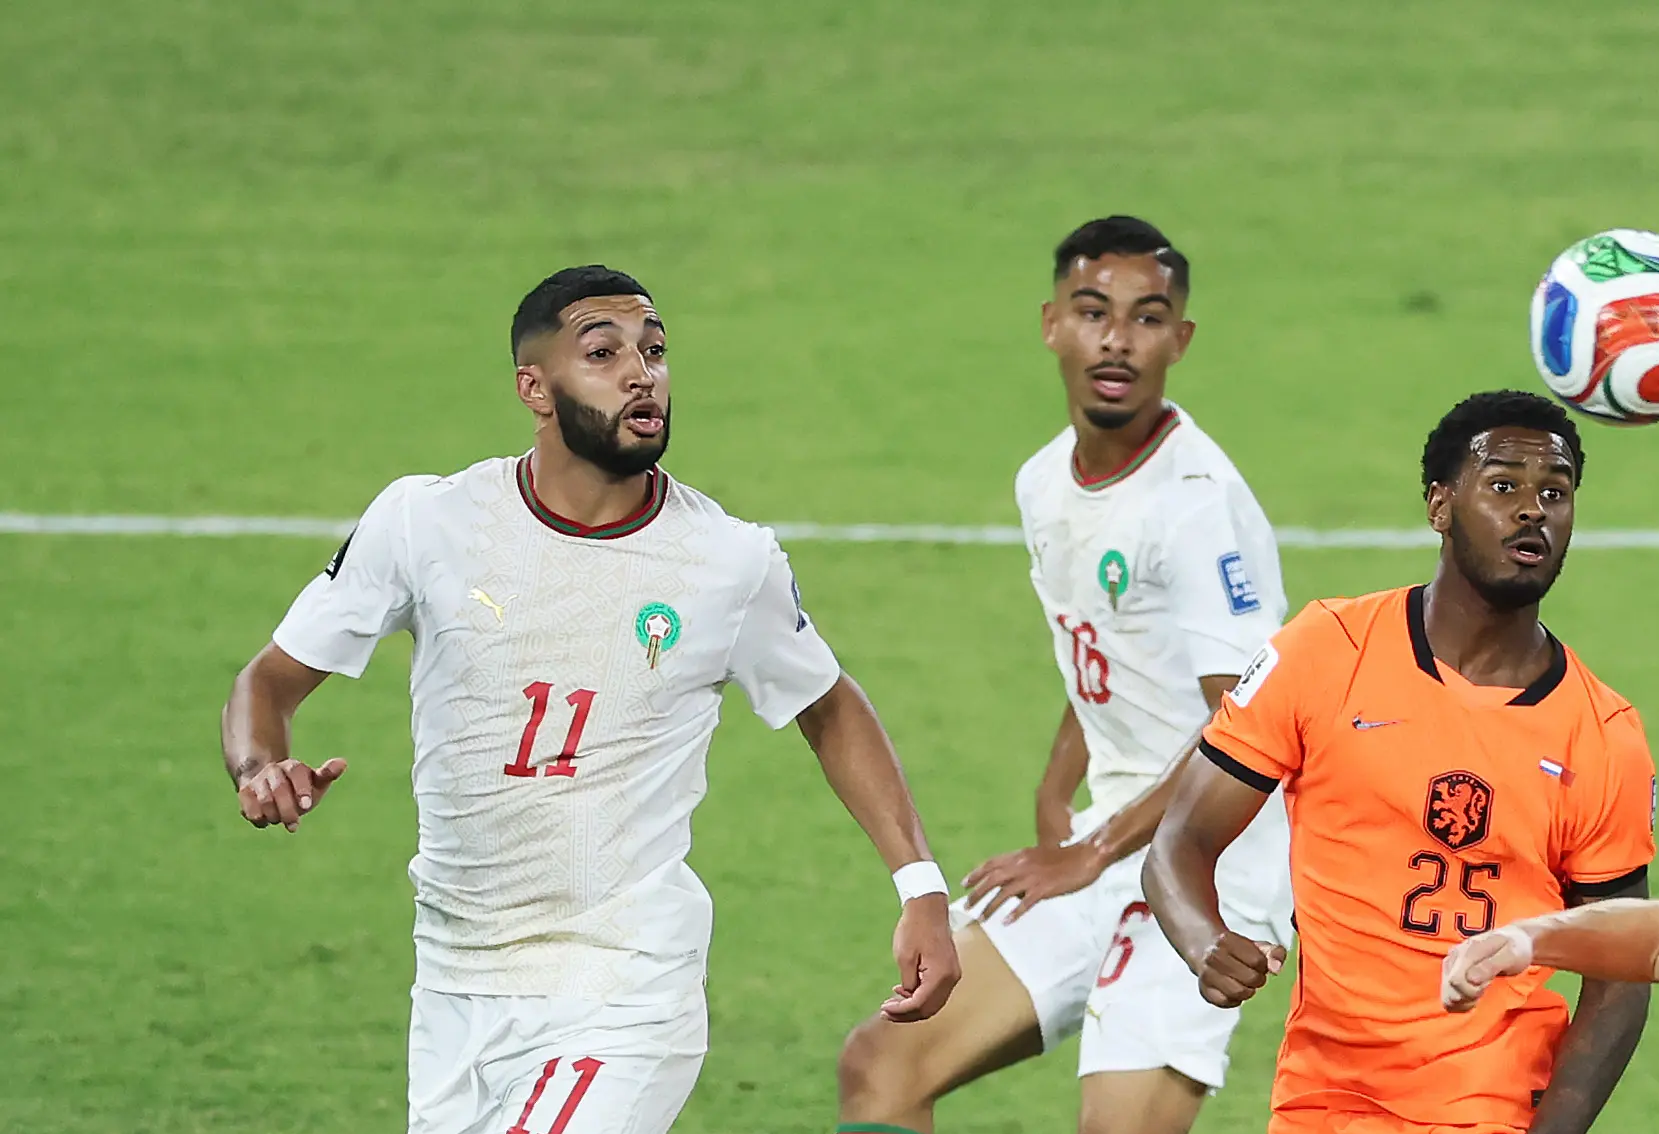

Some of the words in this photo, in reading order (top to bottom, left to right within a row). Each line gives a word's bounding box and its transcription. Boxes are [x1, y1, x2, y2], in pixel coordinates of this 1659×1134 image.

[1057, 614, 1112, 705] 16
[503, 680, 598, 777] 11
[1399, 850, 1501, 938] 25
